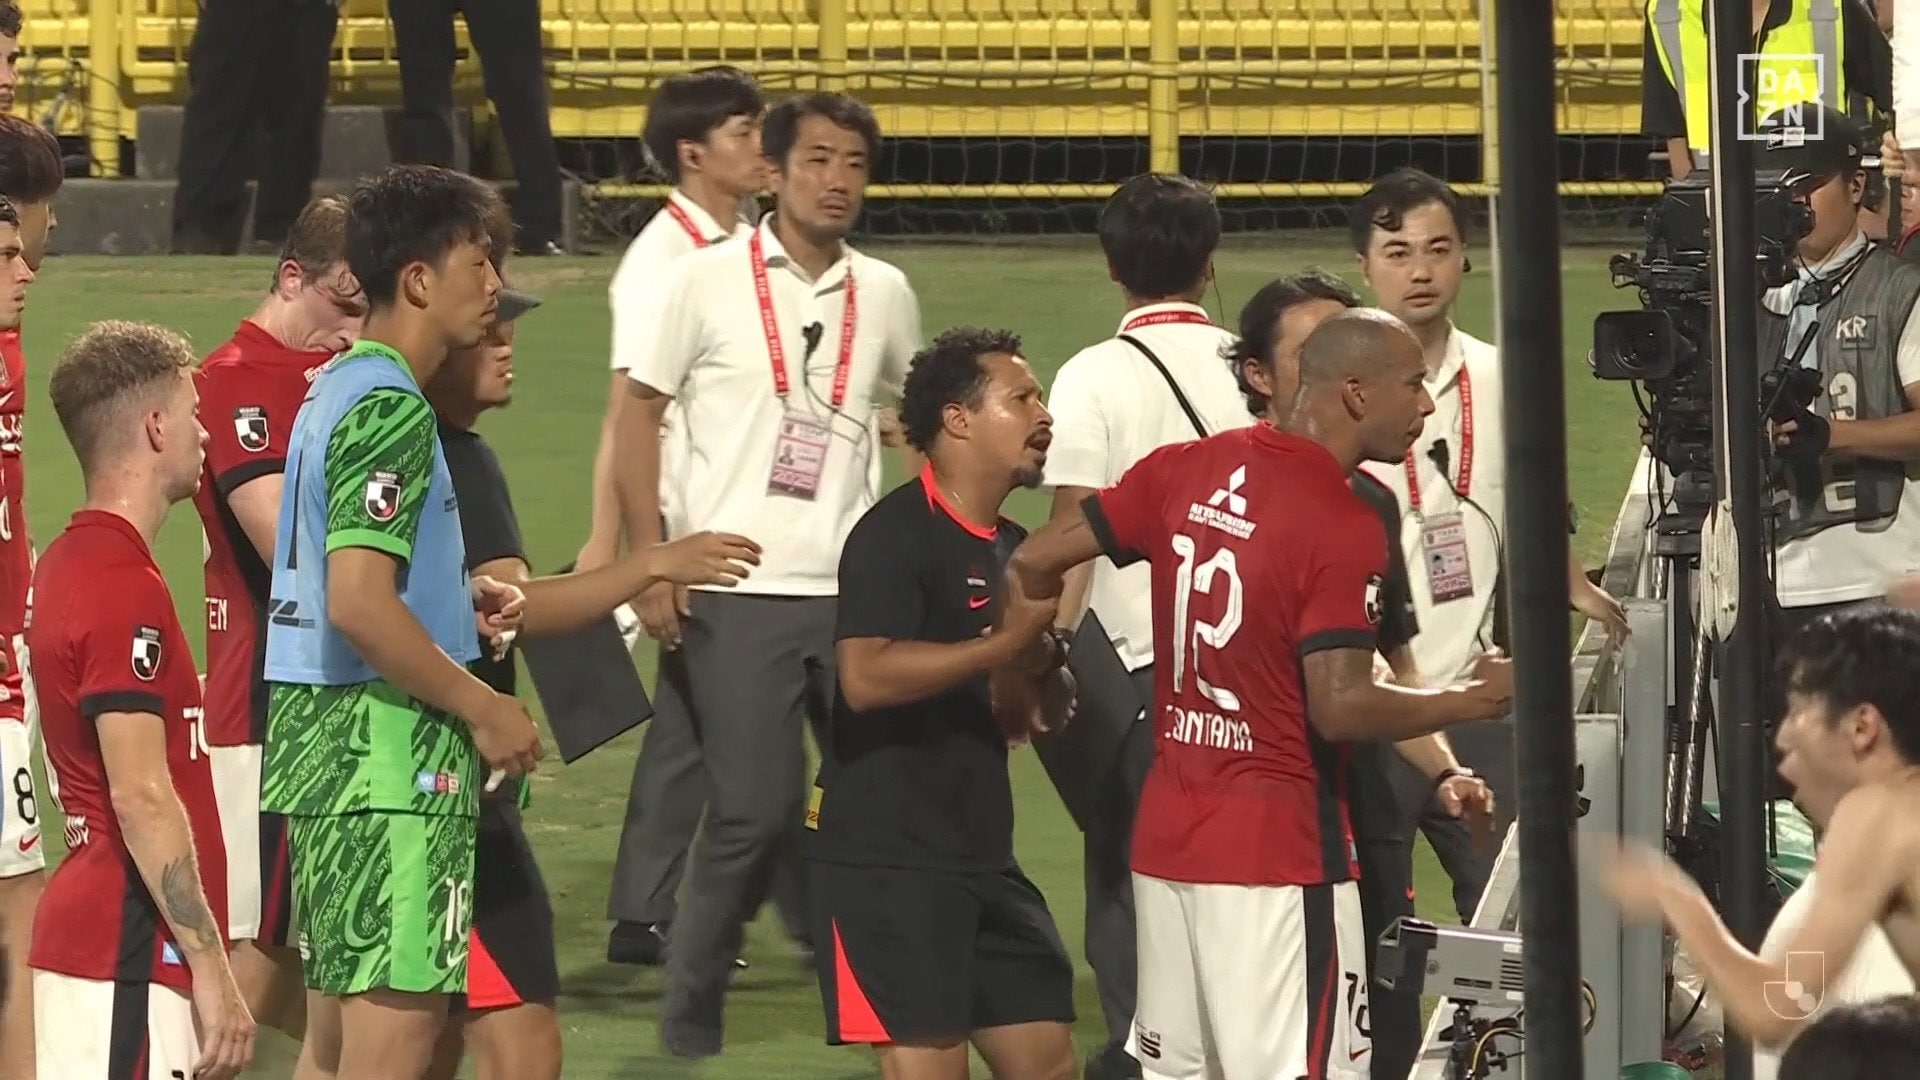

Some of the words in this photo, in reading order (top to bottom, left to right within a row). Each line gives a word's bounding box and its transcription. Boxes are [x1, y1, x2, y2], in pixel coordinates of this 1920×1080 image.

[1835, 315, 1868, 341] KR
[1171, 533, 1244, 712] 12
[13, 767, 37, 825] 8
